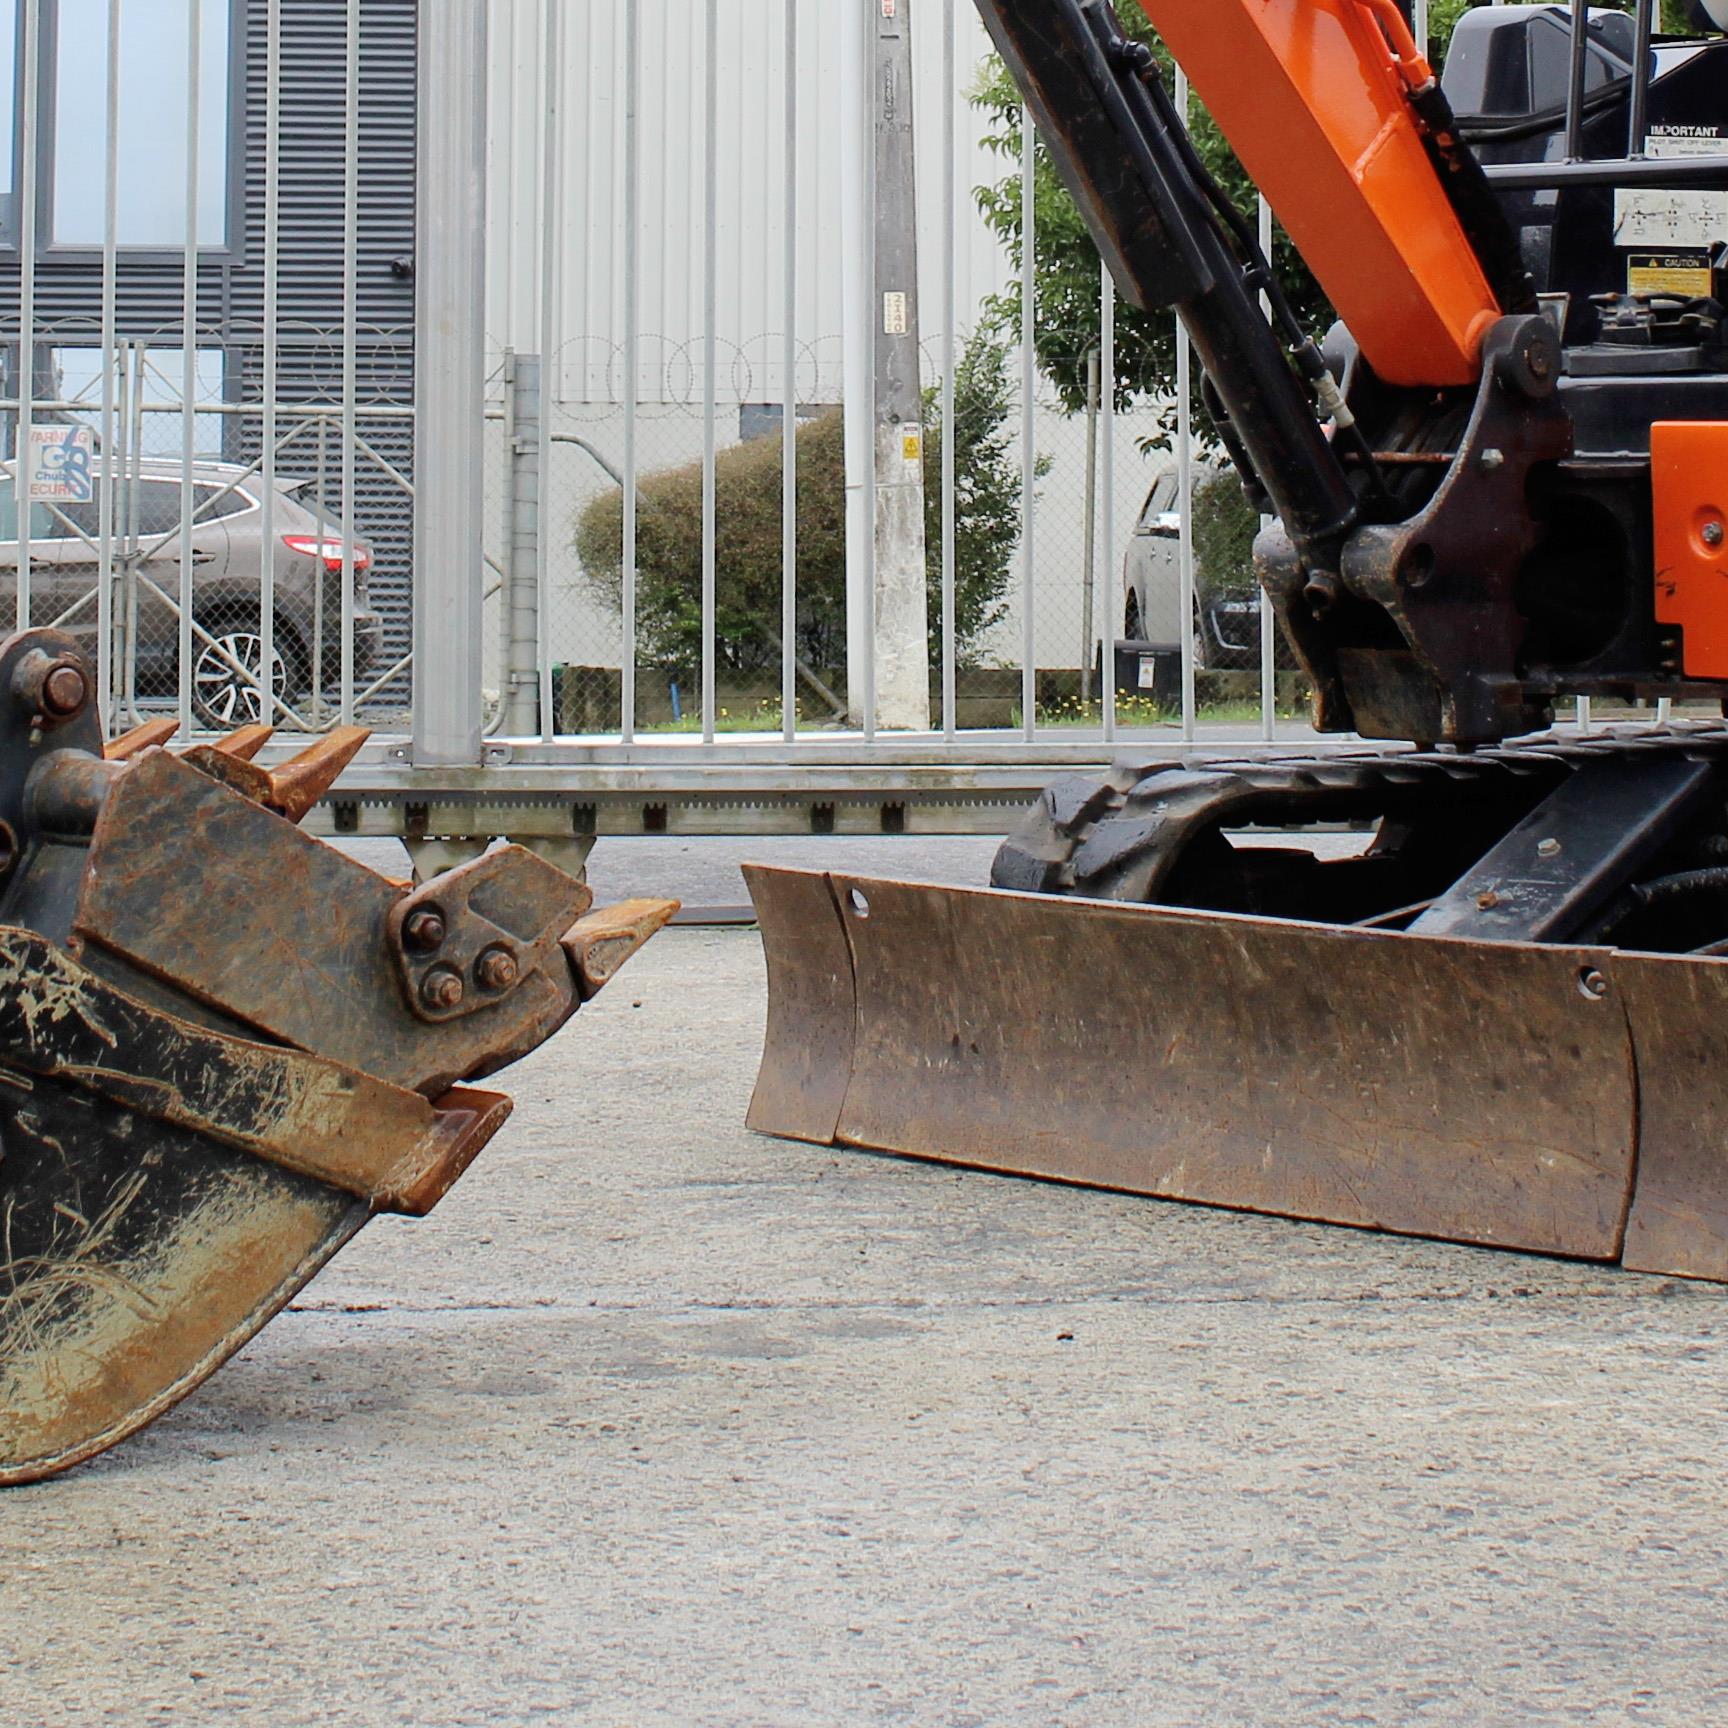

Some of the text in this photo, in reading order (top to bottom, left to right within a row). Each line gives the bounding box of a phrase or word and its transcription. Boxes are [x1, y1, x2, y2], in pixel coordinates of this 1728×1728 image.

[1650, 125, 1719, 137] IMPORTANT
[1664, 258, 1700, 267] CAUTION
[35, 471, 66, 481] Chub
